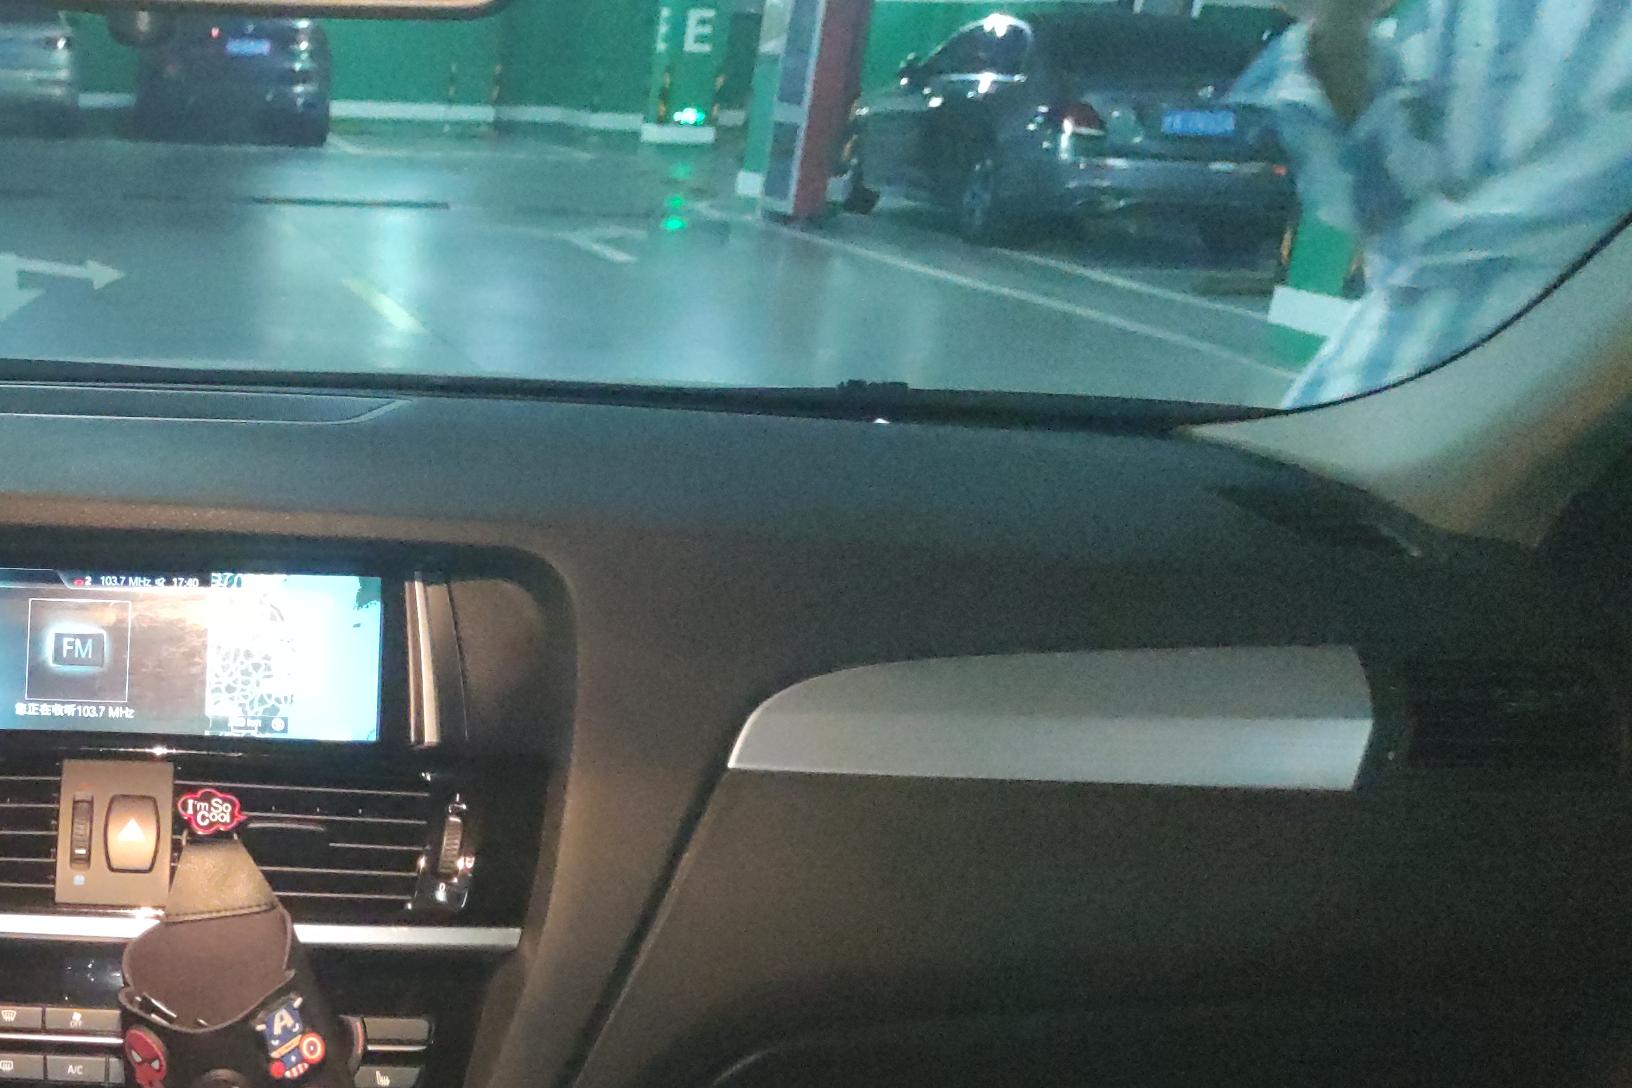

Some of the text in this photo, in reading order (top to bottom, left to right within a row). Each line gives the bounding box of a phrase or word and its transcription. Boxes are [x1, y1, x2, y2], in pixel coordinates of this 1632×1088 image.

[683, 8, 715, 51] E
[100, 575, 125, 587] 103.7
[128, 577, 151, 588] MHz
[62, 637, 93, 660] FM
[108, 706, 136, 719] MHz
[187, 798, 232, 815] I'm So
[196, 810, 231, 826] Cool
[273, 1008, 295, 1036] A
[68, 1064, 83, 1075] A/C
